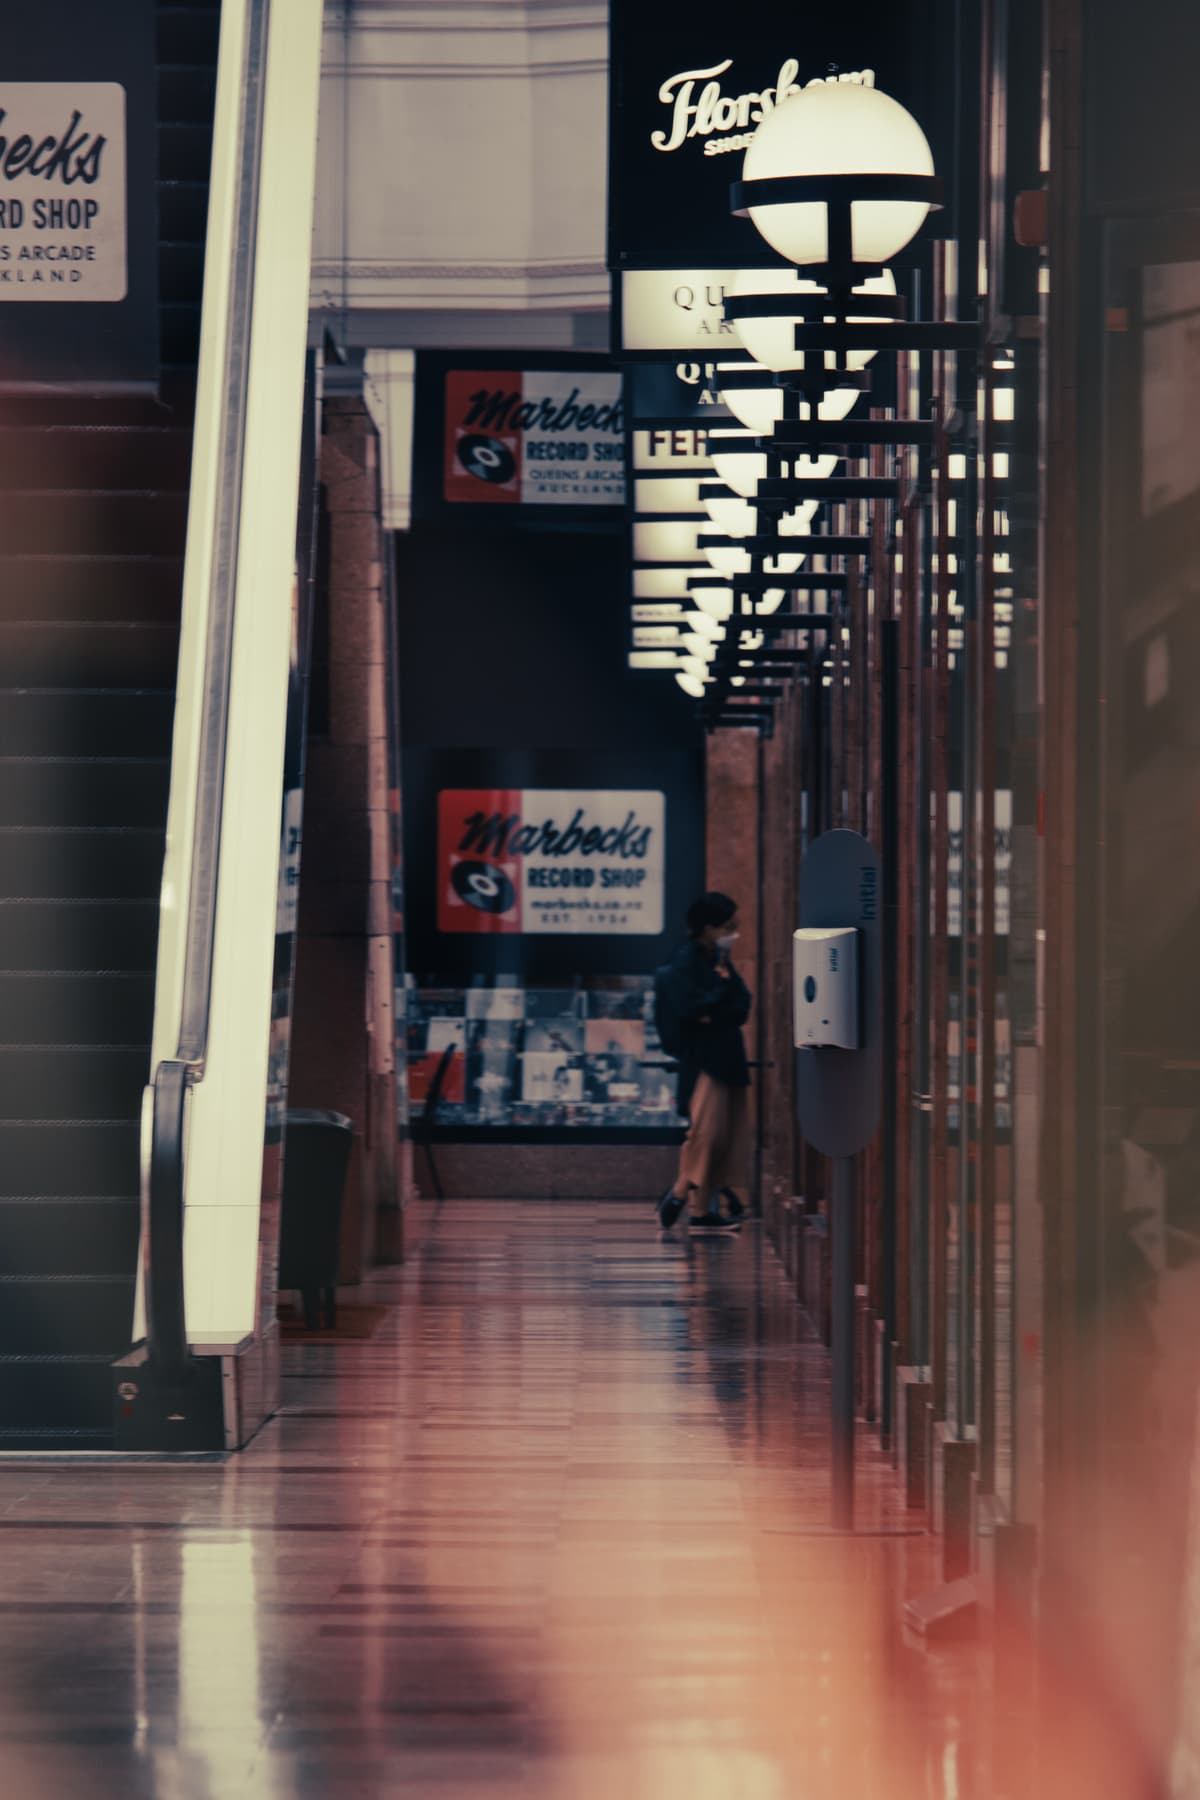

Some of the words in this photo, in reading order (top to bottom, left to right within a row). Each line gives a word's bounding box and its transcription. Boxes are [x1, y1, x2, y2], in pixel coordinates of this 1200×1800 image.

[33, 199, 99, 229] SHOP
[18, 246, 96, 261] ARCADE
[526, 441, 588, 461] RECORD
[529, 469, 580, 481] QUEENS
[459, 808, 652, 859] Marbecks
[527, 868, 595, 888] RECORD
[601, 868, 647, 888] SHOP
